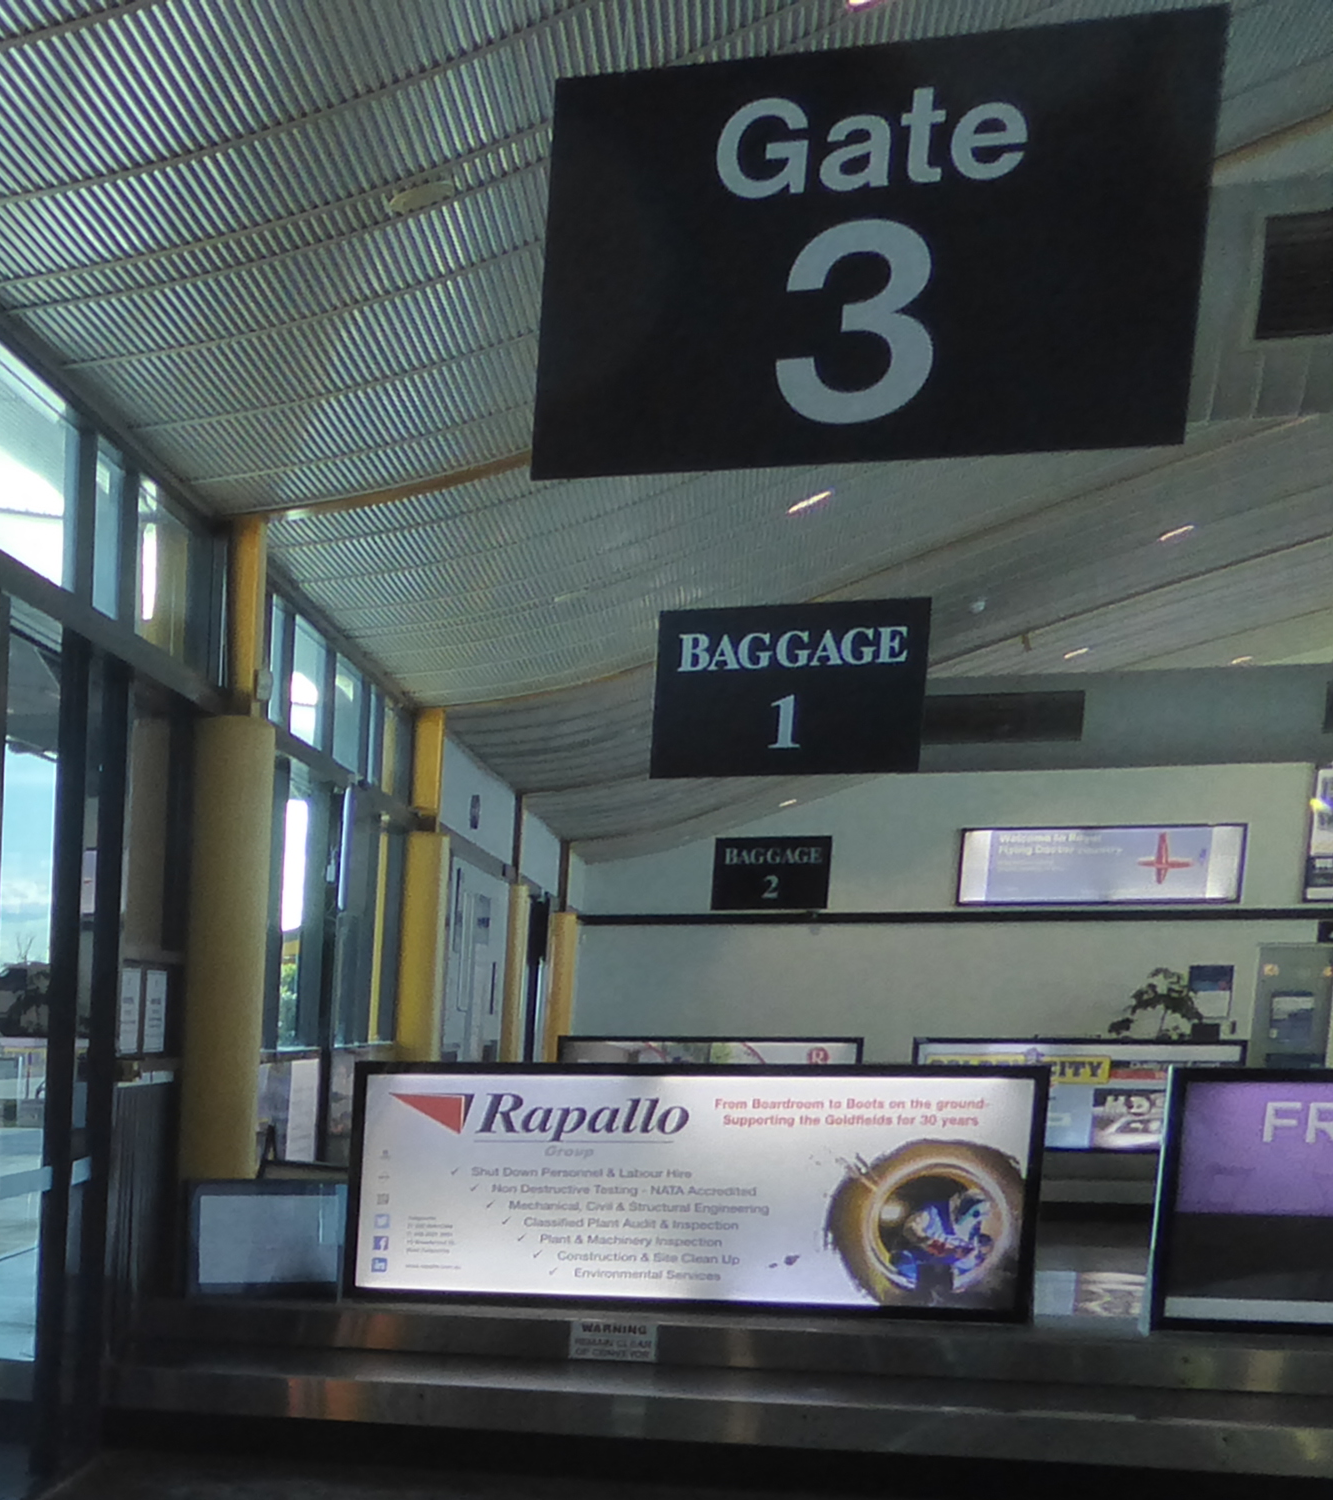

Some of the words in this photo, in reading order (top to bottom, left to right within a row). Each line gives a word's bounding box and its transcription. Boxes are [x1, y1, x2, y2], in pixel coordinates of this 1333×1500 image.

[715, 87, 1029, 199] Gate
[775, 218, 934, 425] 3
[677, 625, 909, 672] BAGGAGE
[767, 694, 800, 749] 1
[724, 847, 823, 865] BAGGAGE
[998, 845, 1033, 857] Flying
[1035, 845, 1075, 855] Doctor
[761, 875, 779, 899] 2
[714, 1098, 747, 1110] From
[751, 1098, 824, 1110] Boardroom
[828, 1099, 842, 1110] to
[846, 1099, 884, 1110] Boots
[888, 1100, 906, 1110] on
[910, 1098, 931, 1110] the
[475, 1092, 690, 1143] Rapallo
[723, 1114, 795, 1128] Supporting
[799, 1115, 820, 1126] the
[824, 1114, 892, 1126] Goldfields
[896, 1114, 916, 1126] for
[920, 1115, 937, 1126] 30
[941, 1116, 979, 1129] years
[544, 1146, 594, 1158] Group
[471, 1166, 500, 1178] Shut
[503, 1166, 538, 1178] Down
[541, 1167, 603, 1179] Personnel
[606, 1168, 616, 1179] &
[619, 1168, 664, 1179] Labour
[667, 1168, 692, 1180] Hire
[492, 1183, 515, 1194] Non
[520, 1183, 590, 1195] Destructive
[593, 1184, 638, 1198] Testing
[650, 1186, 685, 1197] NATA
[688, 1186, 757, 1198] Accredited
[509, 1200, 582, 1213] Mechanical,
[586, 1200, 612, 1212] Civil
[615, 1201, 626, 1212] &
[629, 1201, 690, 1213] Structural
[694, 1203, 769, 1217] Engineering
[524, 1216, 583, 1229] Classified
[587, 1217, 619, 1229] Plant
[622, 1217, 656, 1229] Audit
[659, 1218, 669, 1230] &
[672, 1218, 739, 1232] Inspection
[540, 1233, 572, 1245] Plant
[574, 1234, 584, 1245] &
[587, 1234, 652, 1248] Machinery
[655, 1235, 723, 1249] Inspection
[557, 1250, 634, 1263] Construction
[638, 1252, 649, 1263] &
[653, 1252, 678, 1264] Site
[681, 1252, 718, 1265] Clean
[721, 1254, 740, 1267] Up
[574, 1267, 663, 1280] Environmental
[666, 1269, 721, 1282] Services
[581, 1322, 647, 1335] WARNING
